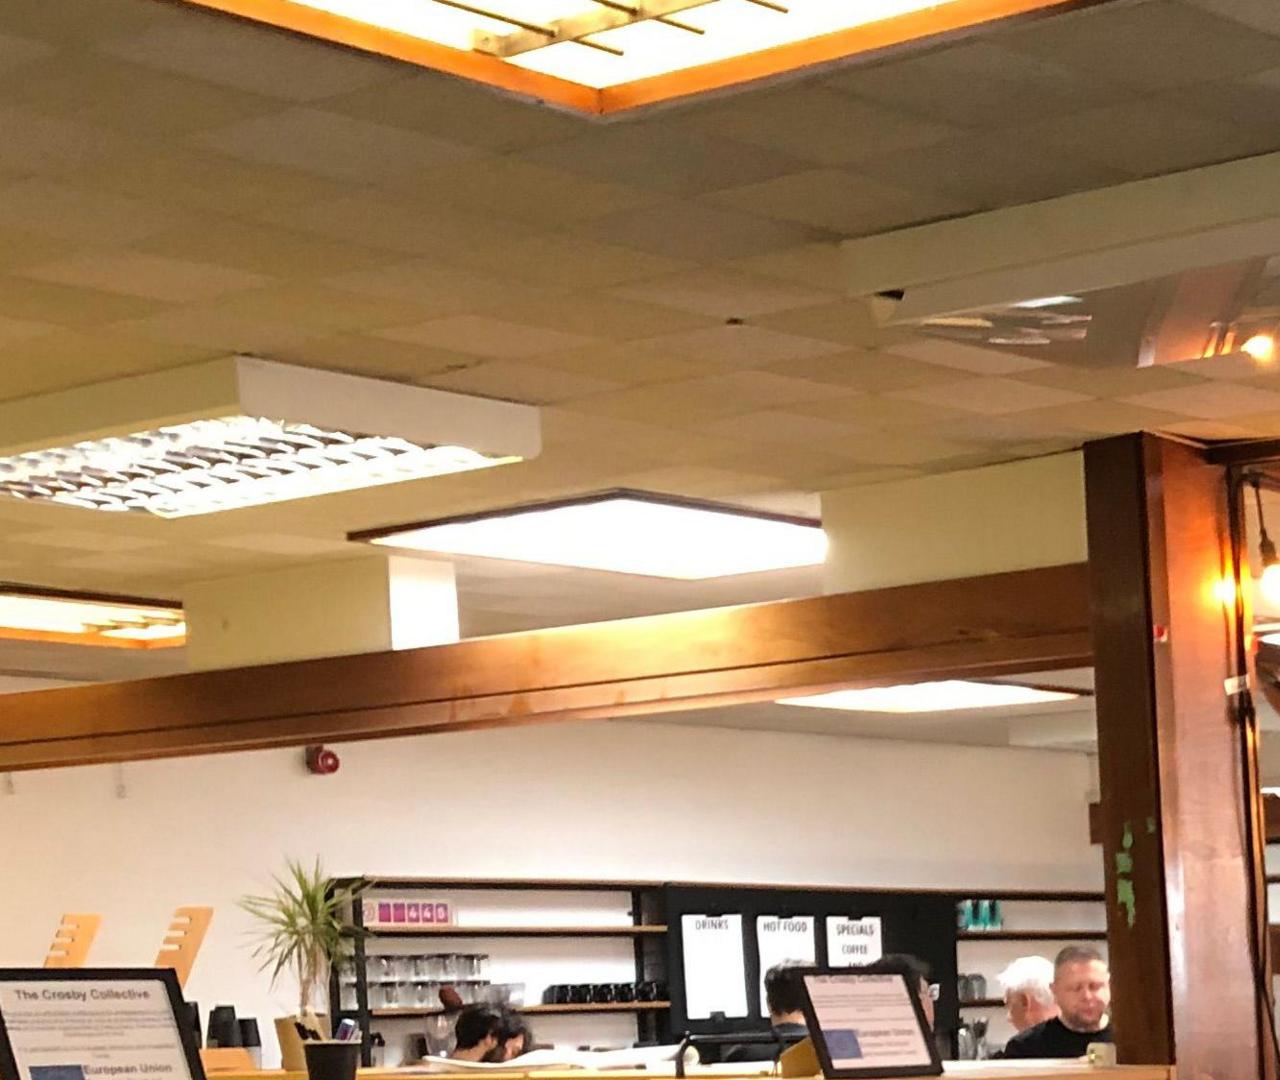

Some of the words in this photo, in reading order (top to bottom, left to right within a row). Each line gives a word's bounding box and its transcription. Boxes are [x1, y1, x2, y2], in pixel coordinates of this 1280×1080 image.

[695, 919, 729, 930] DRINKS
[763, 920, 781, 932] HOT
[783, 921, 807, 932] FOOD
[836, 924, 874, 936] SPECIALS
[14, 989, 38, 1000] The
[42, 989, 87, 1002] Crosby
[90, 988, 150, 999] Collective
[83, 1064, 138, 1076] European
[139, 1063, 173, 1073] Union
